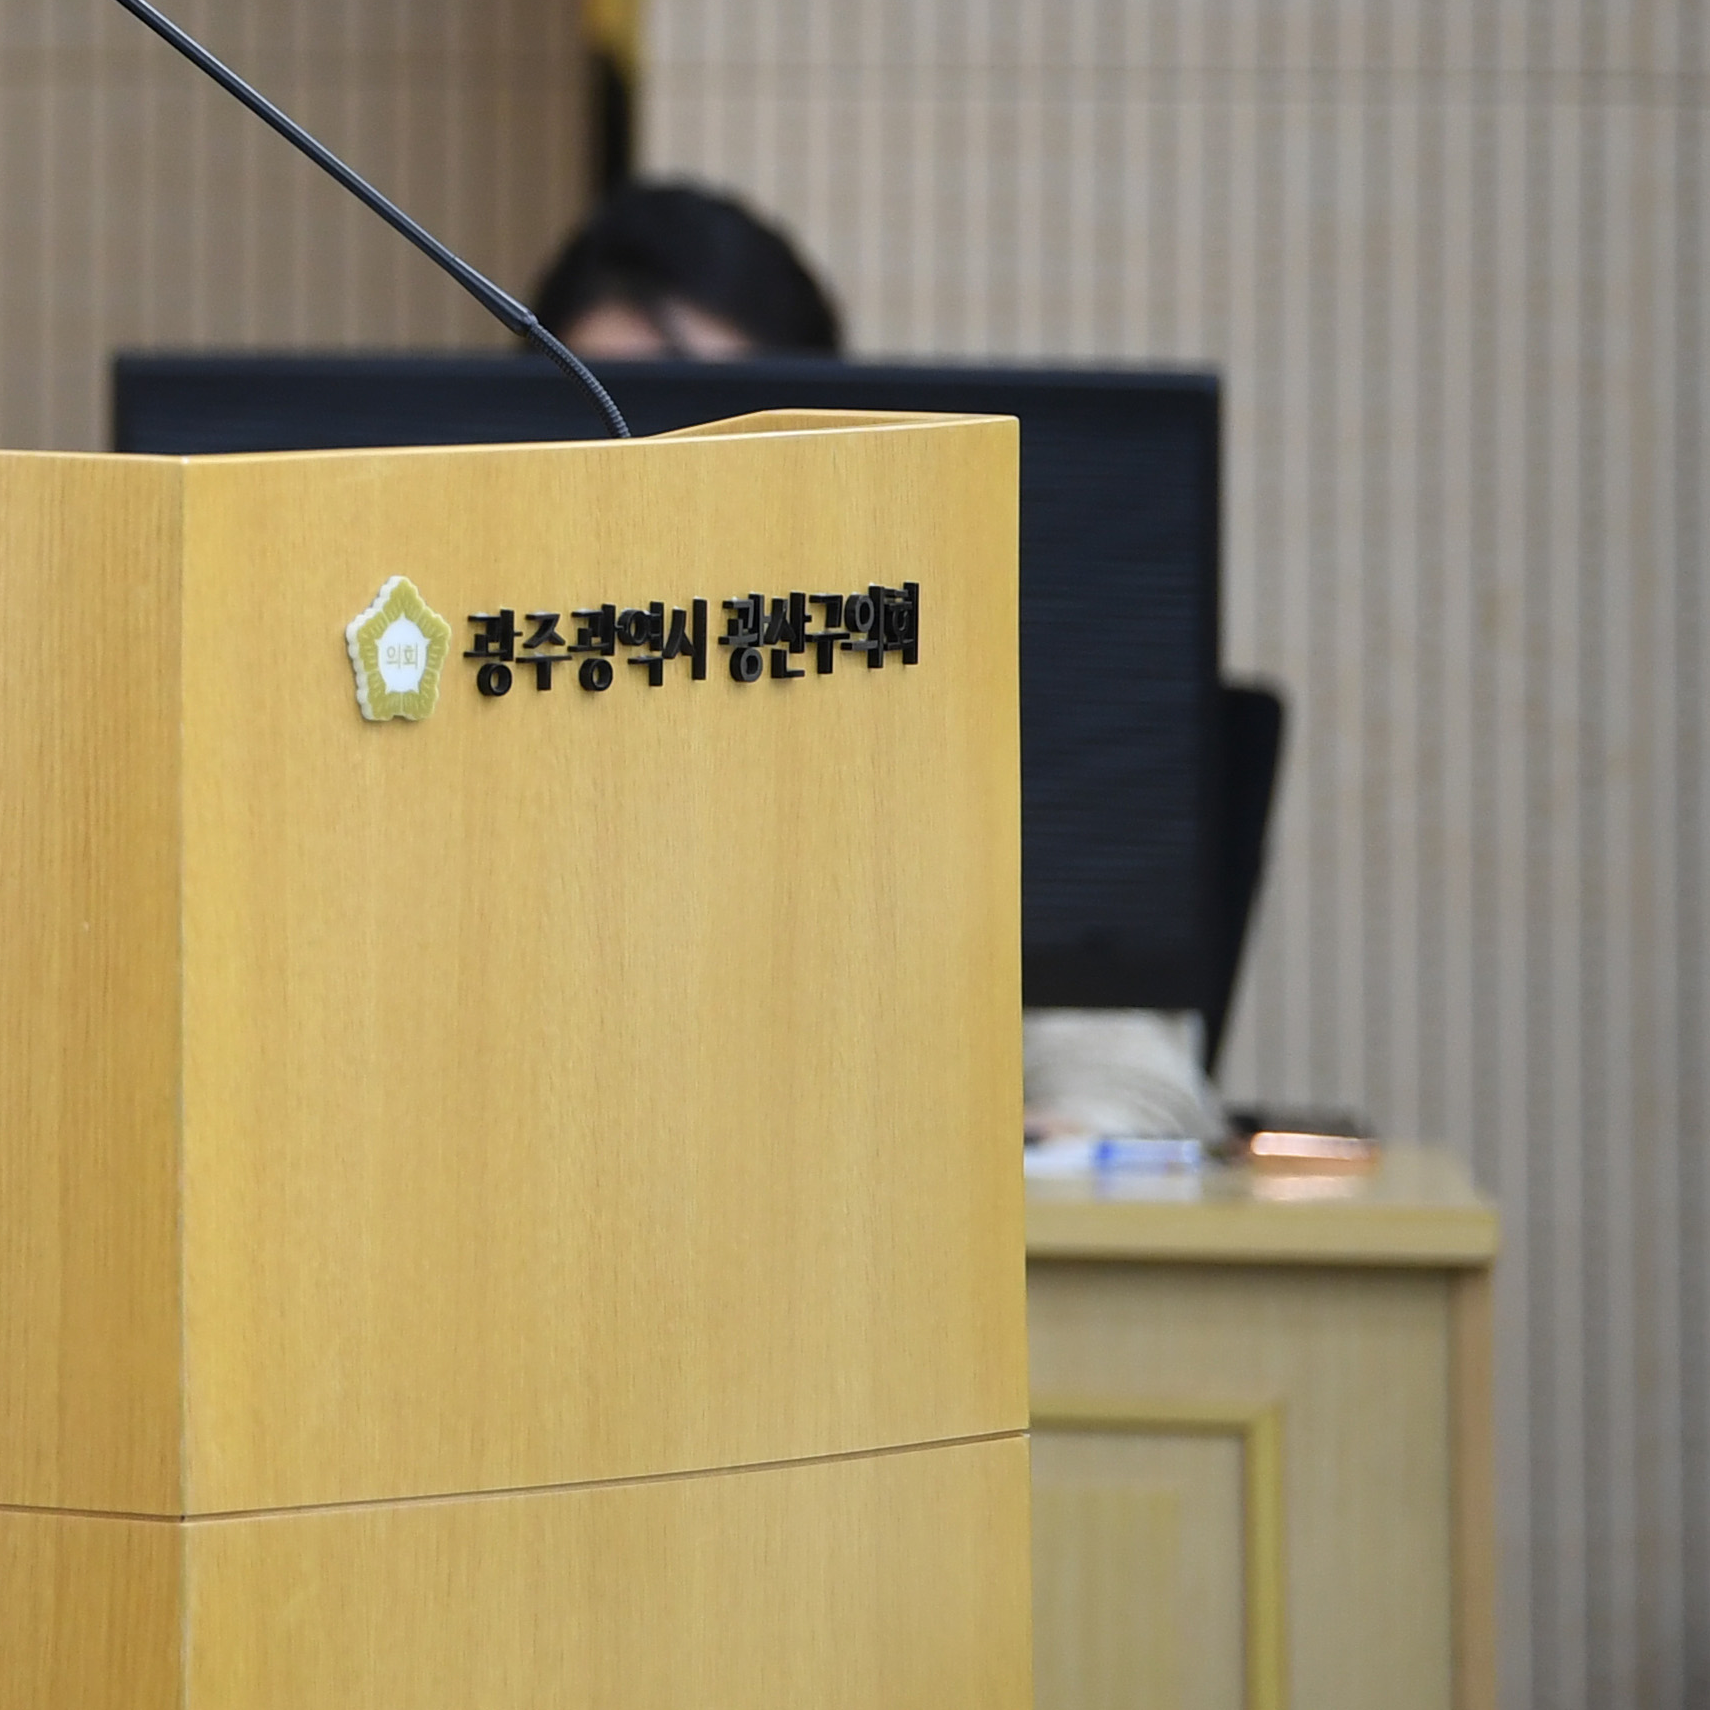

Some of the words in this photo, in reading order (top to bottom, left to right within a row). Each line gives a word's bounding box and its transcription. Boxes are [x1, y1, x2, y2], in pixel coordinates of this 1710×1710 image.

[385, 642, 419, 669] 의회
[463, 596, 708, 697] 광주광역시
[718, 581, 920, 683] 광산구의회
